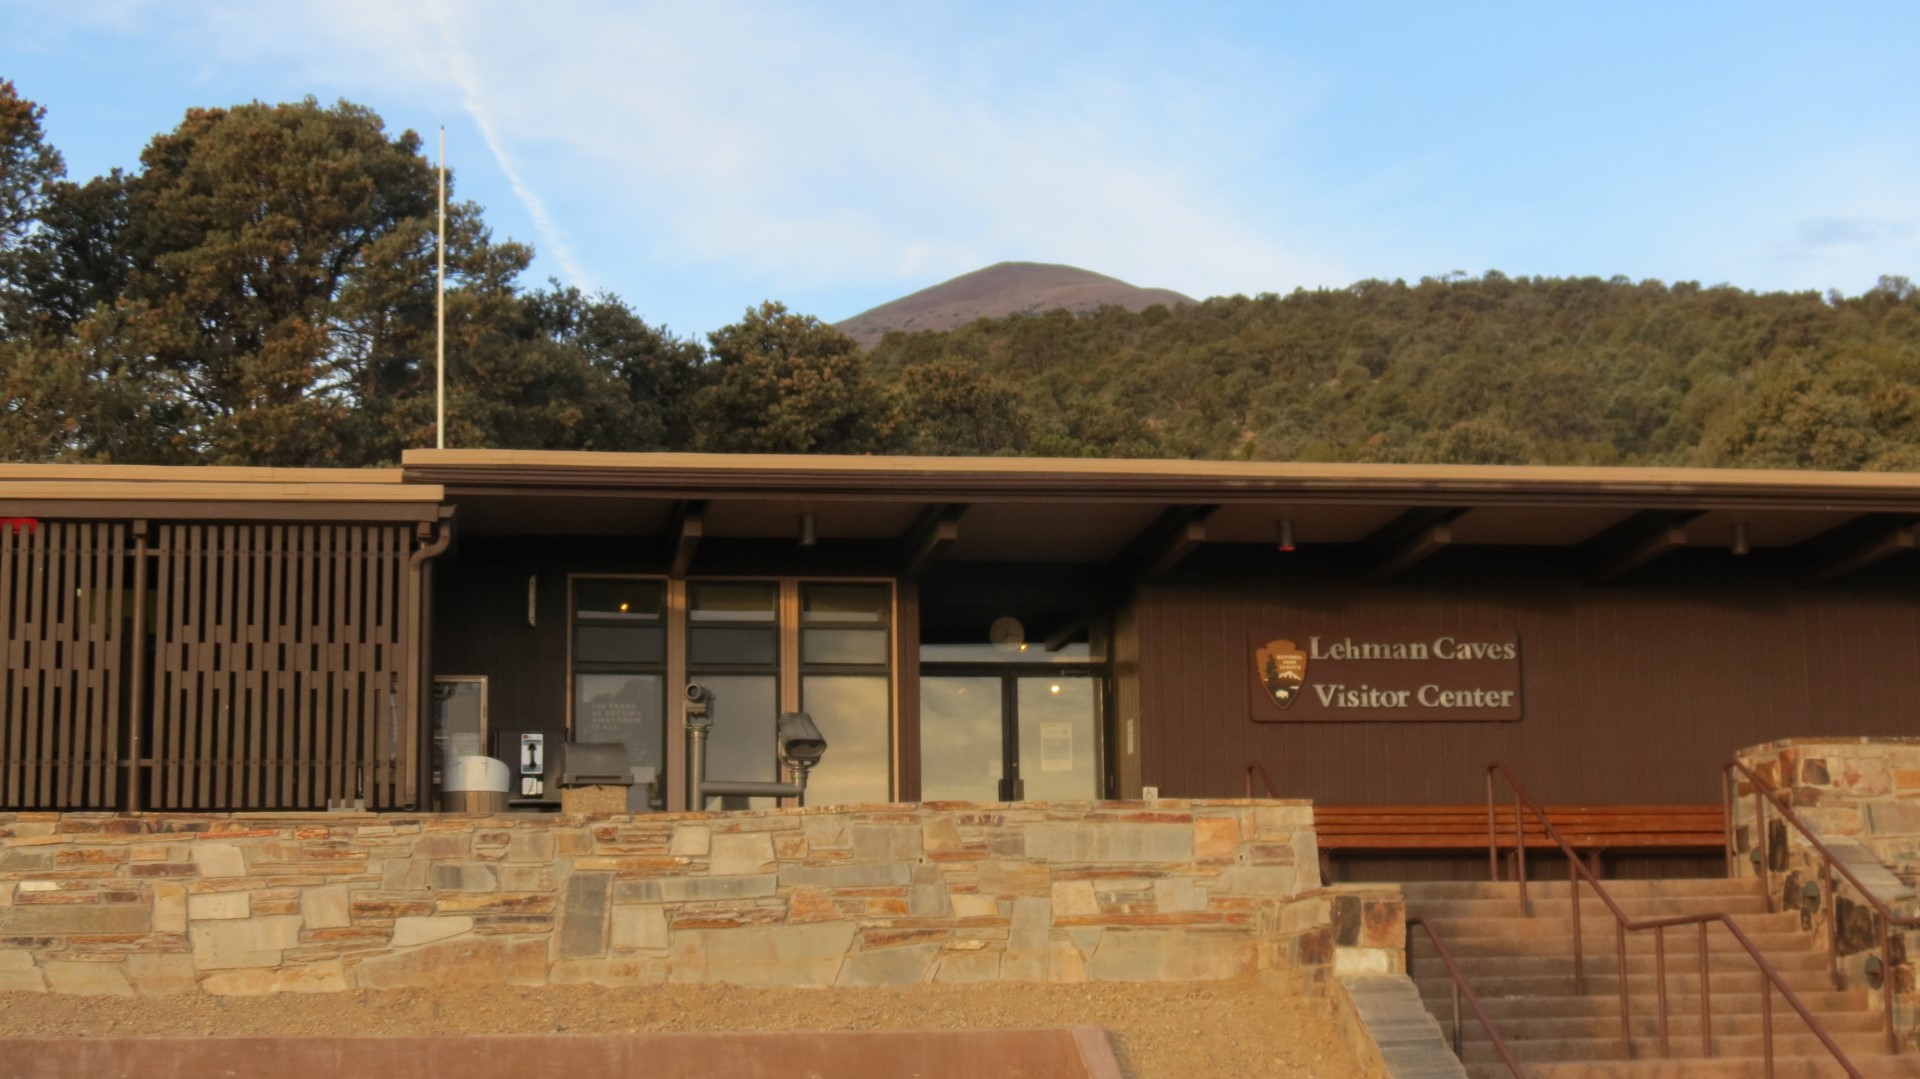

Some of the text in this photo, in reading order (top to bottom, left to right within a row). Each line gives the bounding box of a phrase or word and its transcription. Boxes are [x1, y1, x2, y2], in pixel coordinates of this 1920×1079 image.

[1310, 637, 1516, 660] Lehman Caves
[1312, 684, 1514, 708] Visitor Center
